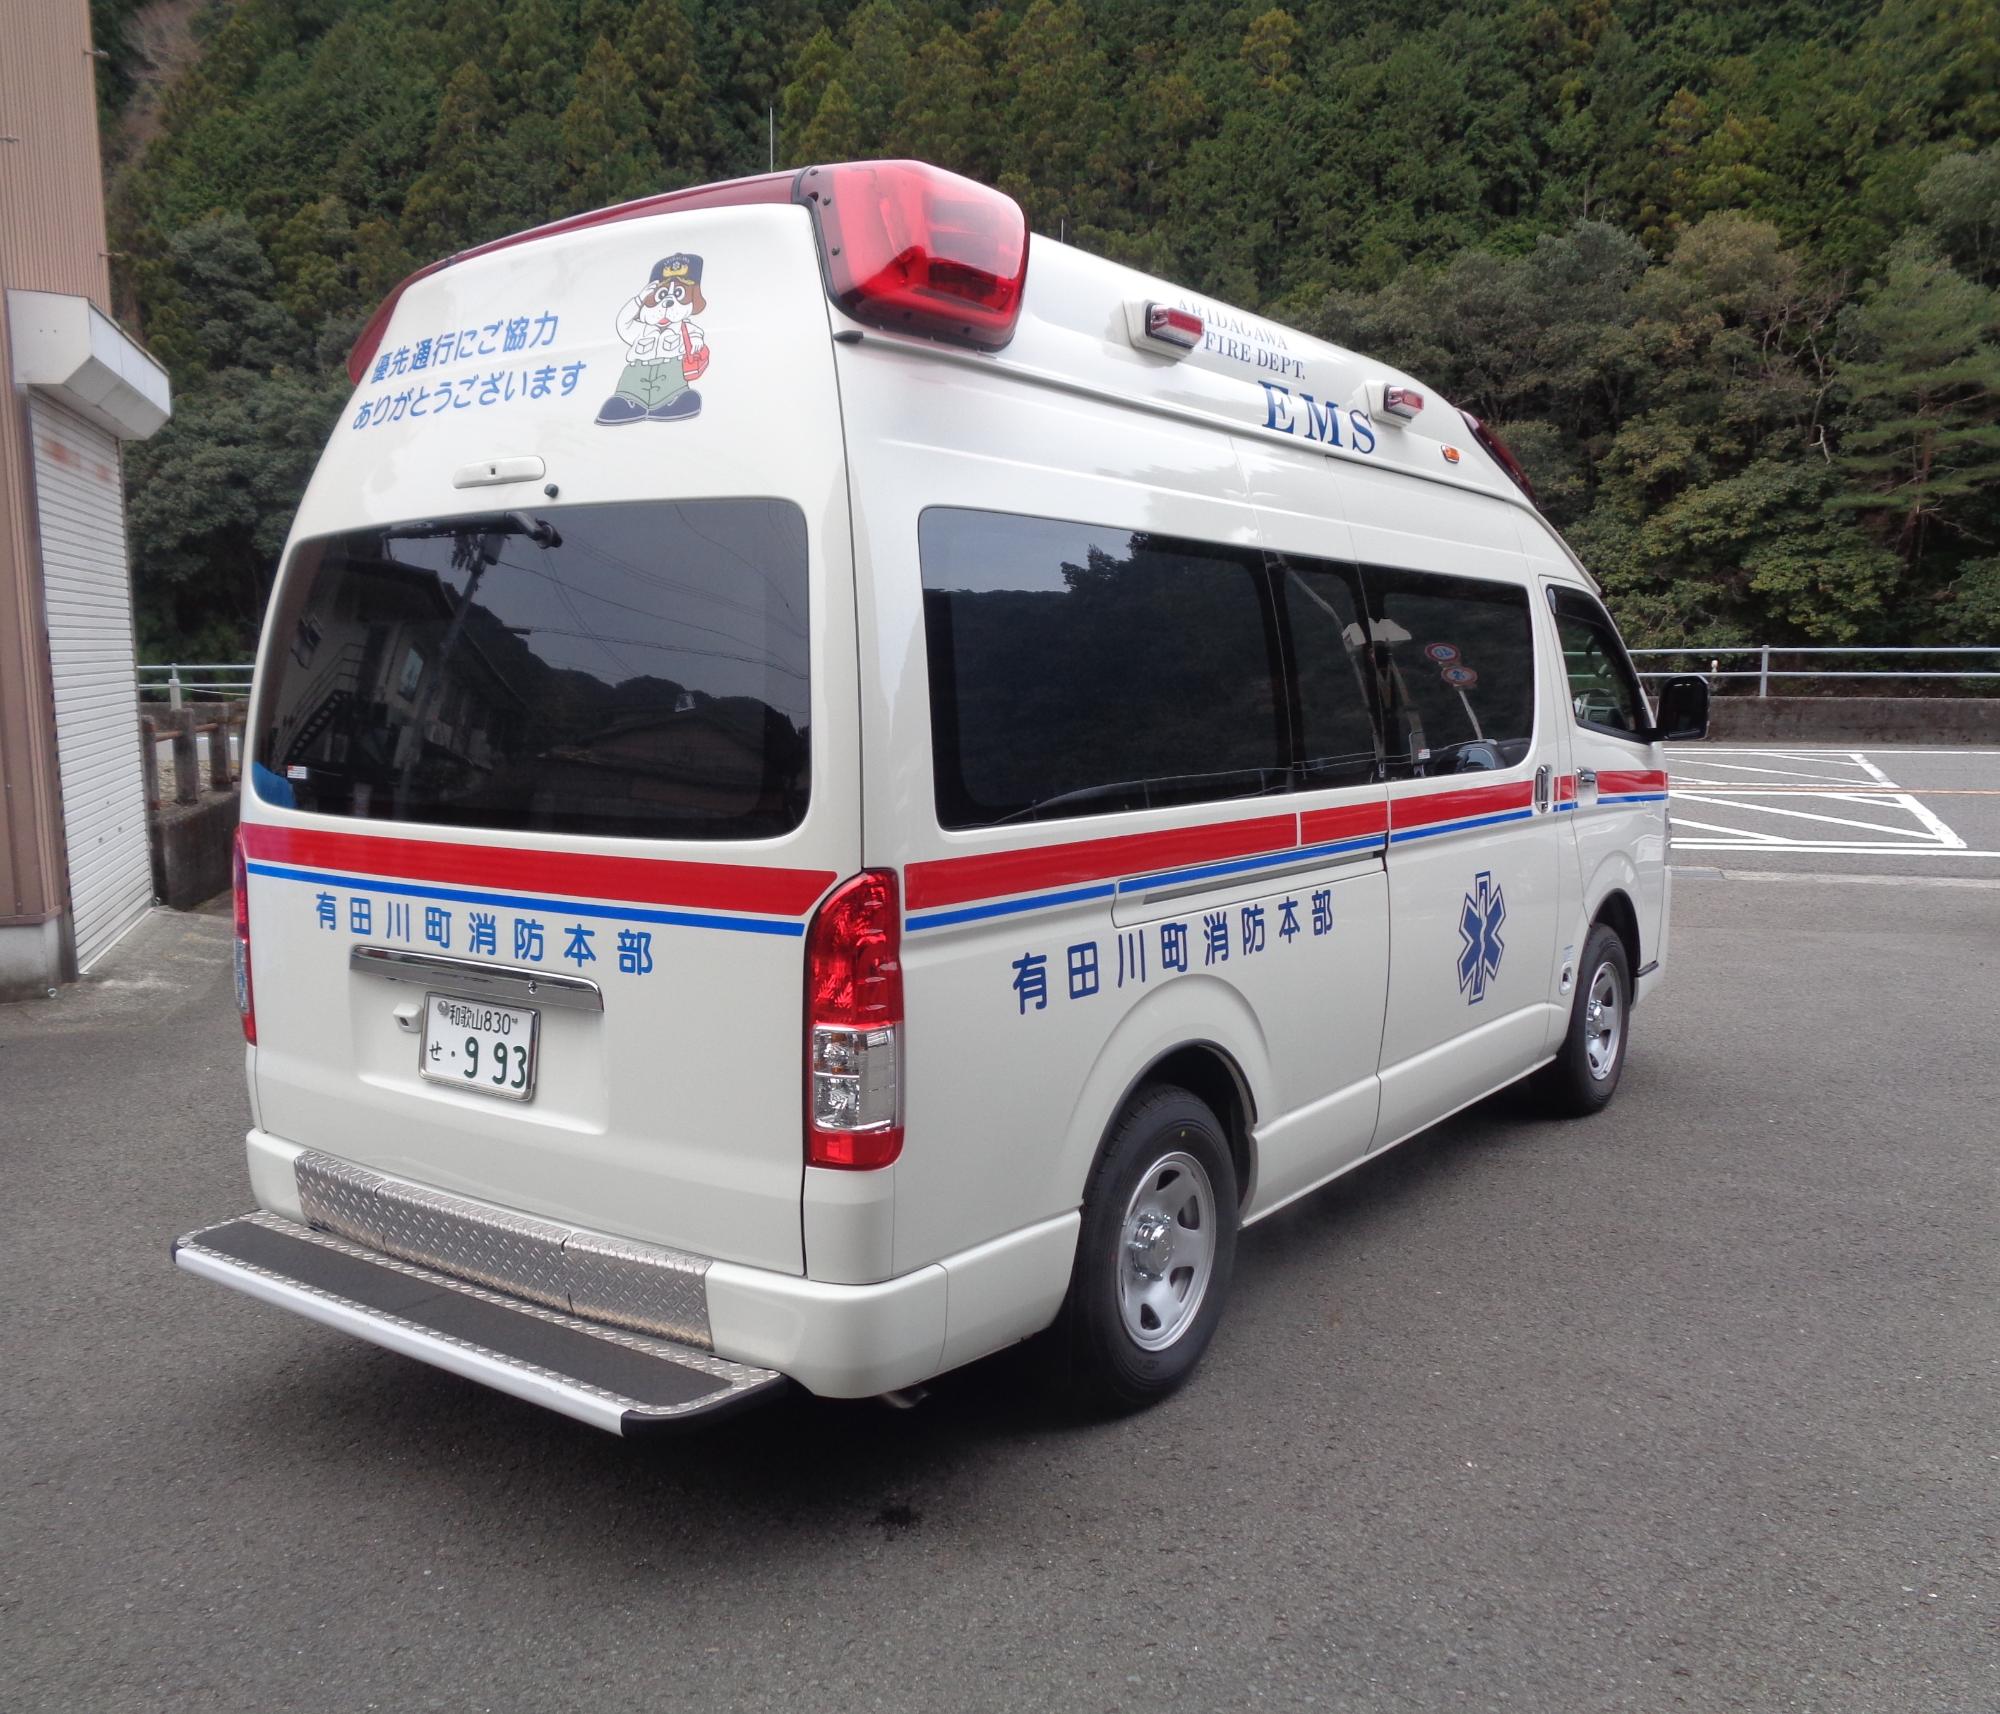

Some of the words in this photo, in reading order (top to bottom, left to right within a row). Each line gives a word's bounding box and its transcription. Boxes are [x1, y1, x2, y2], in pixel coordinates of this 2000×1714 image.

[370, 310, 560, 385] 優先通行にご協力
[1204, 330, 1251, 364] FIRE
[1256, 347, 1306, 380] DEPT.
[352, 360, 587, 430] ありがとうございます
[1257, 379, 1376, 455] EMS
[315, 891, 654, 976] 有田川町消防本部
[1011, 888, 1334, 1016] 有田川町消防本部
